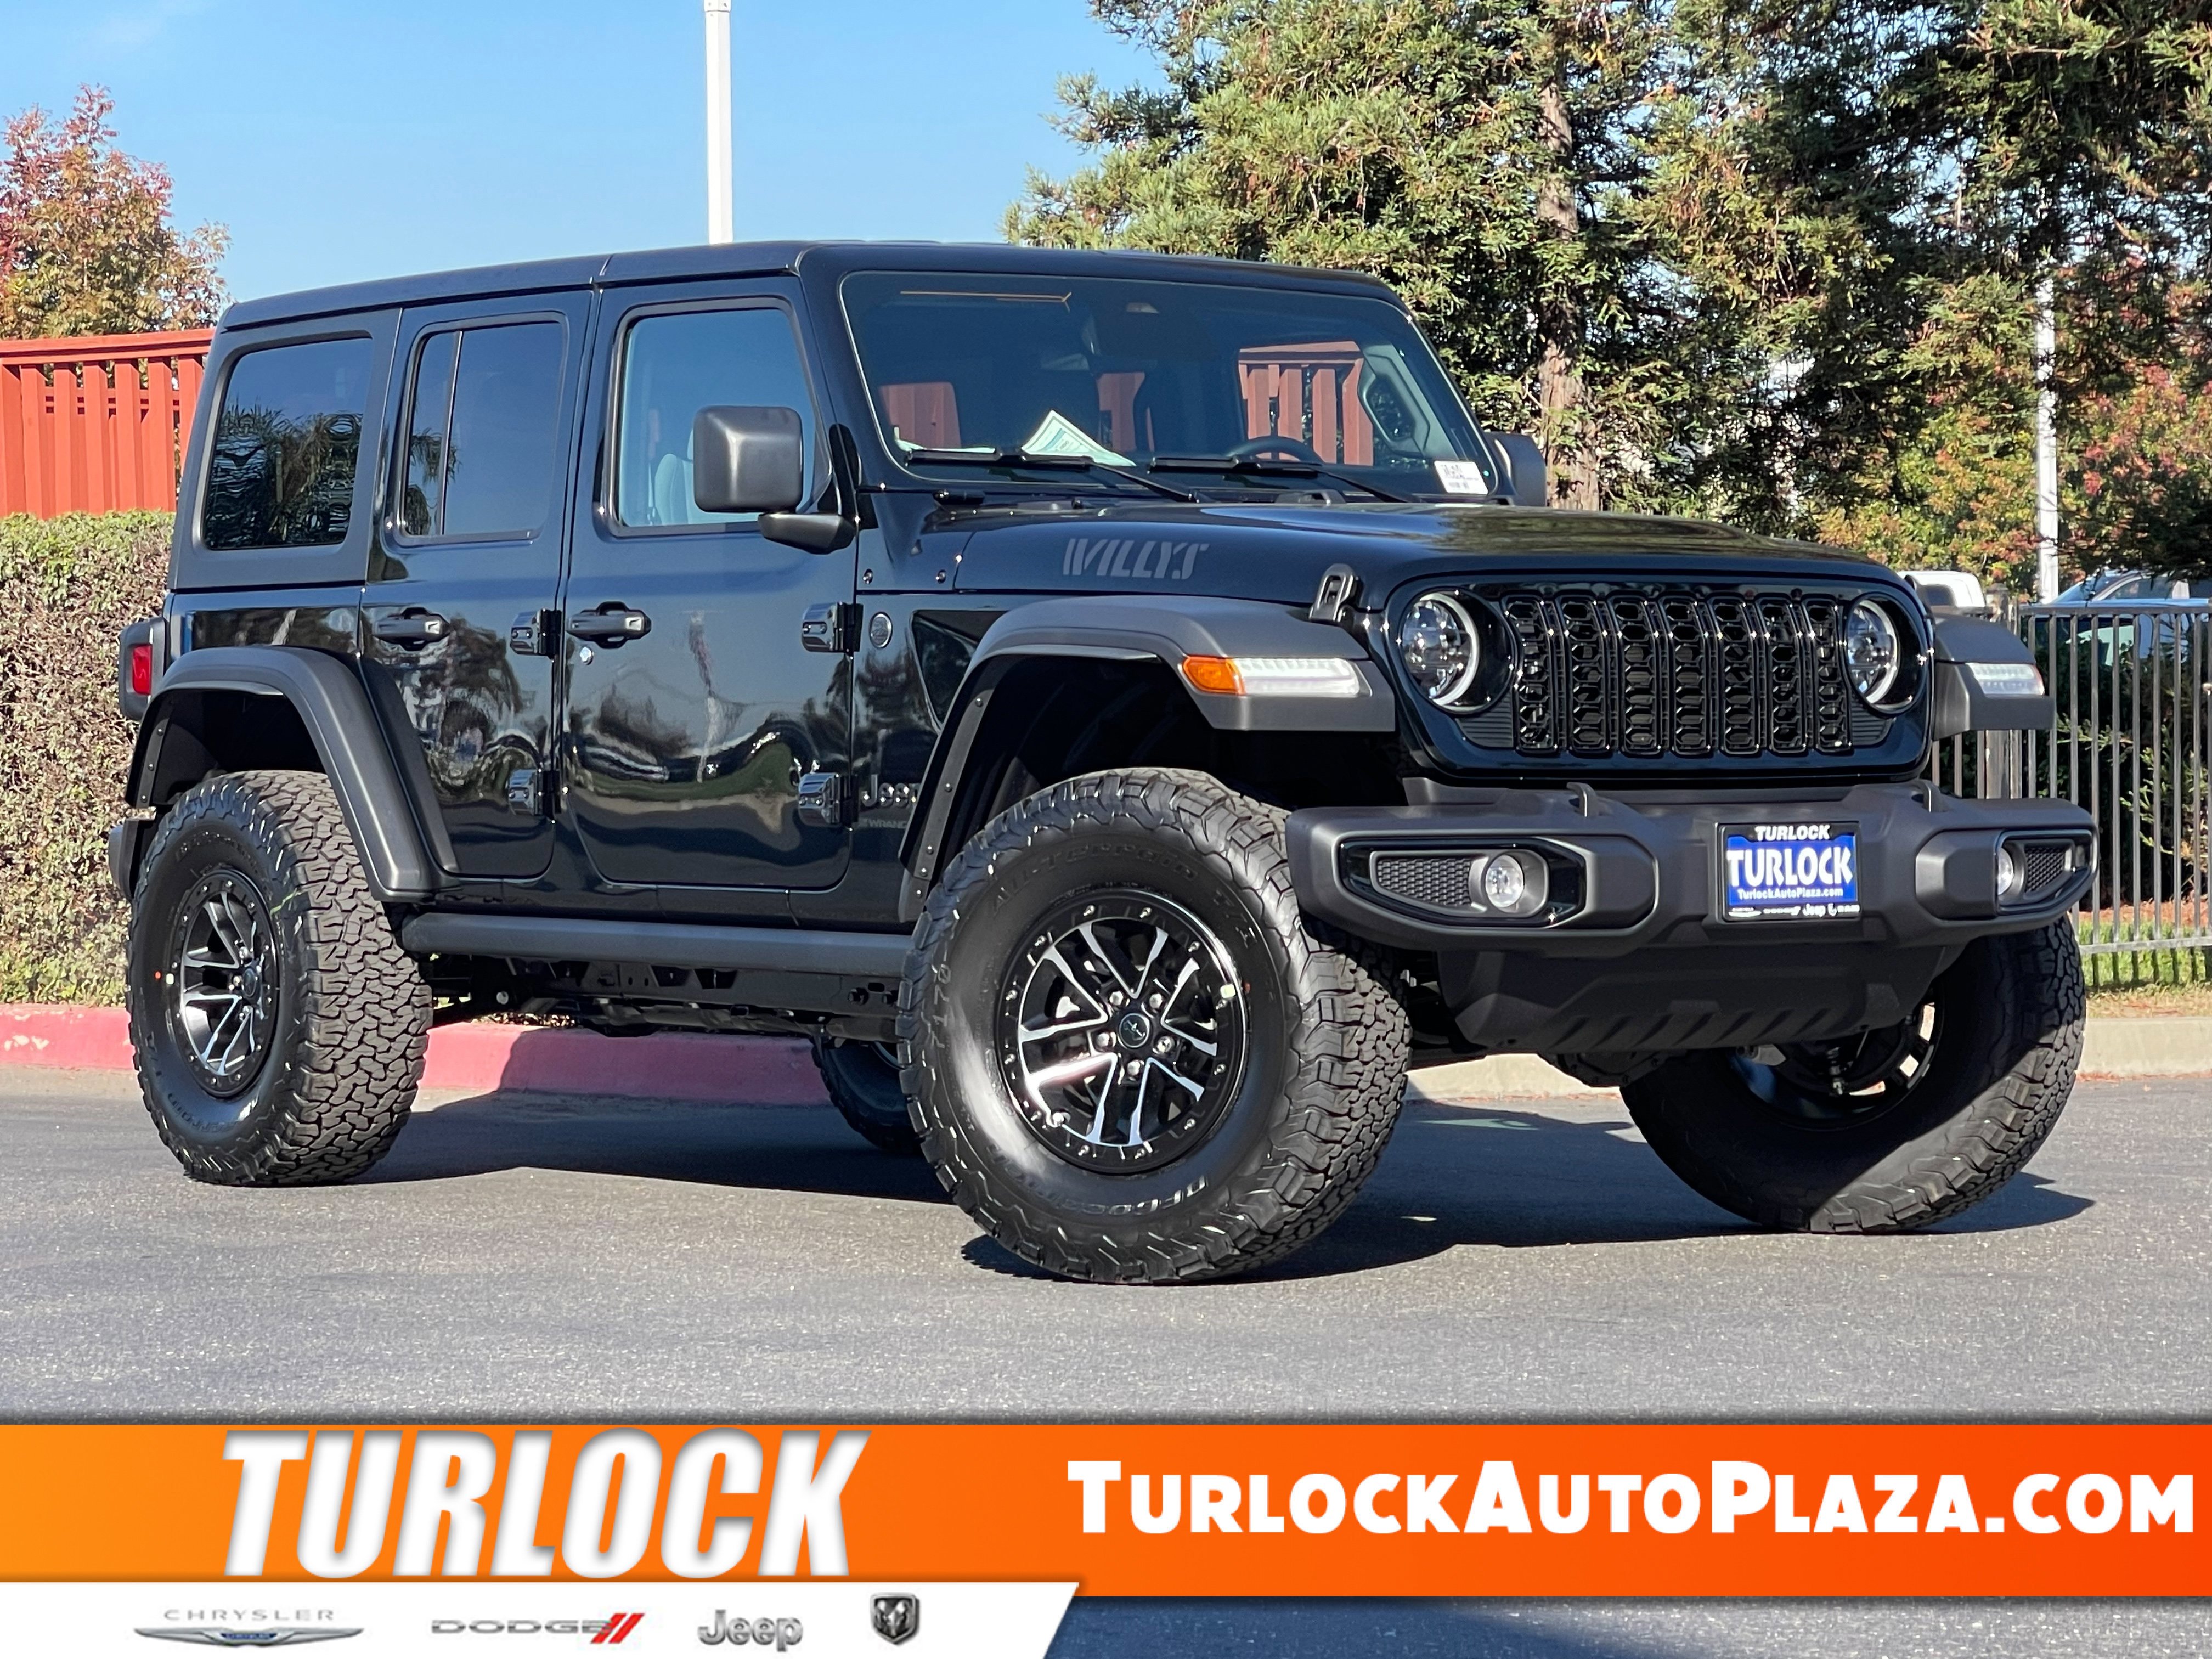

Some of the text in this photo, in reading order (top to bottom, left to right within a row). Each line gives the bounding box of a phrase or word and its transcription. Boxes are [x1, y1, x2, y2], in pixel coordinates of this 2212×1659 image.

[1063, 538, 1209, 579] WILLYS
[867, 819, 908, 828] WRANG
[1754, 825, 1830, 841] TURLOCK
[1726, 847, 1853, 887] TURLOCK
[1737, 888, 1844, 900] TurlockAutoPlaza.com
